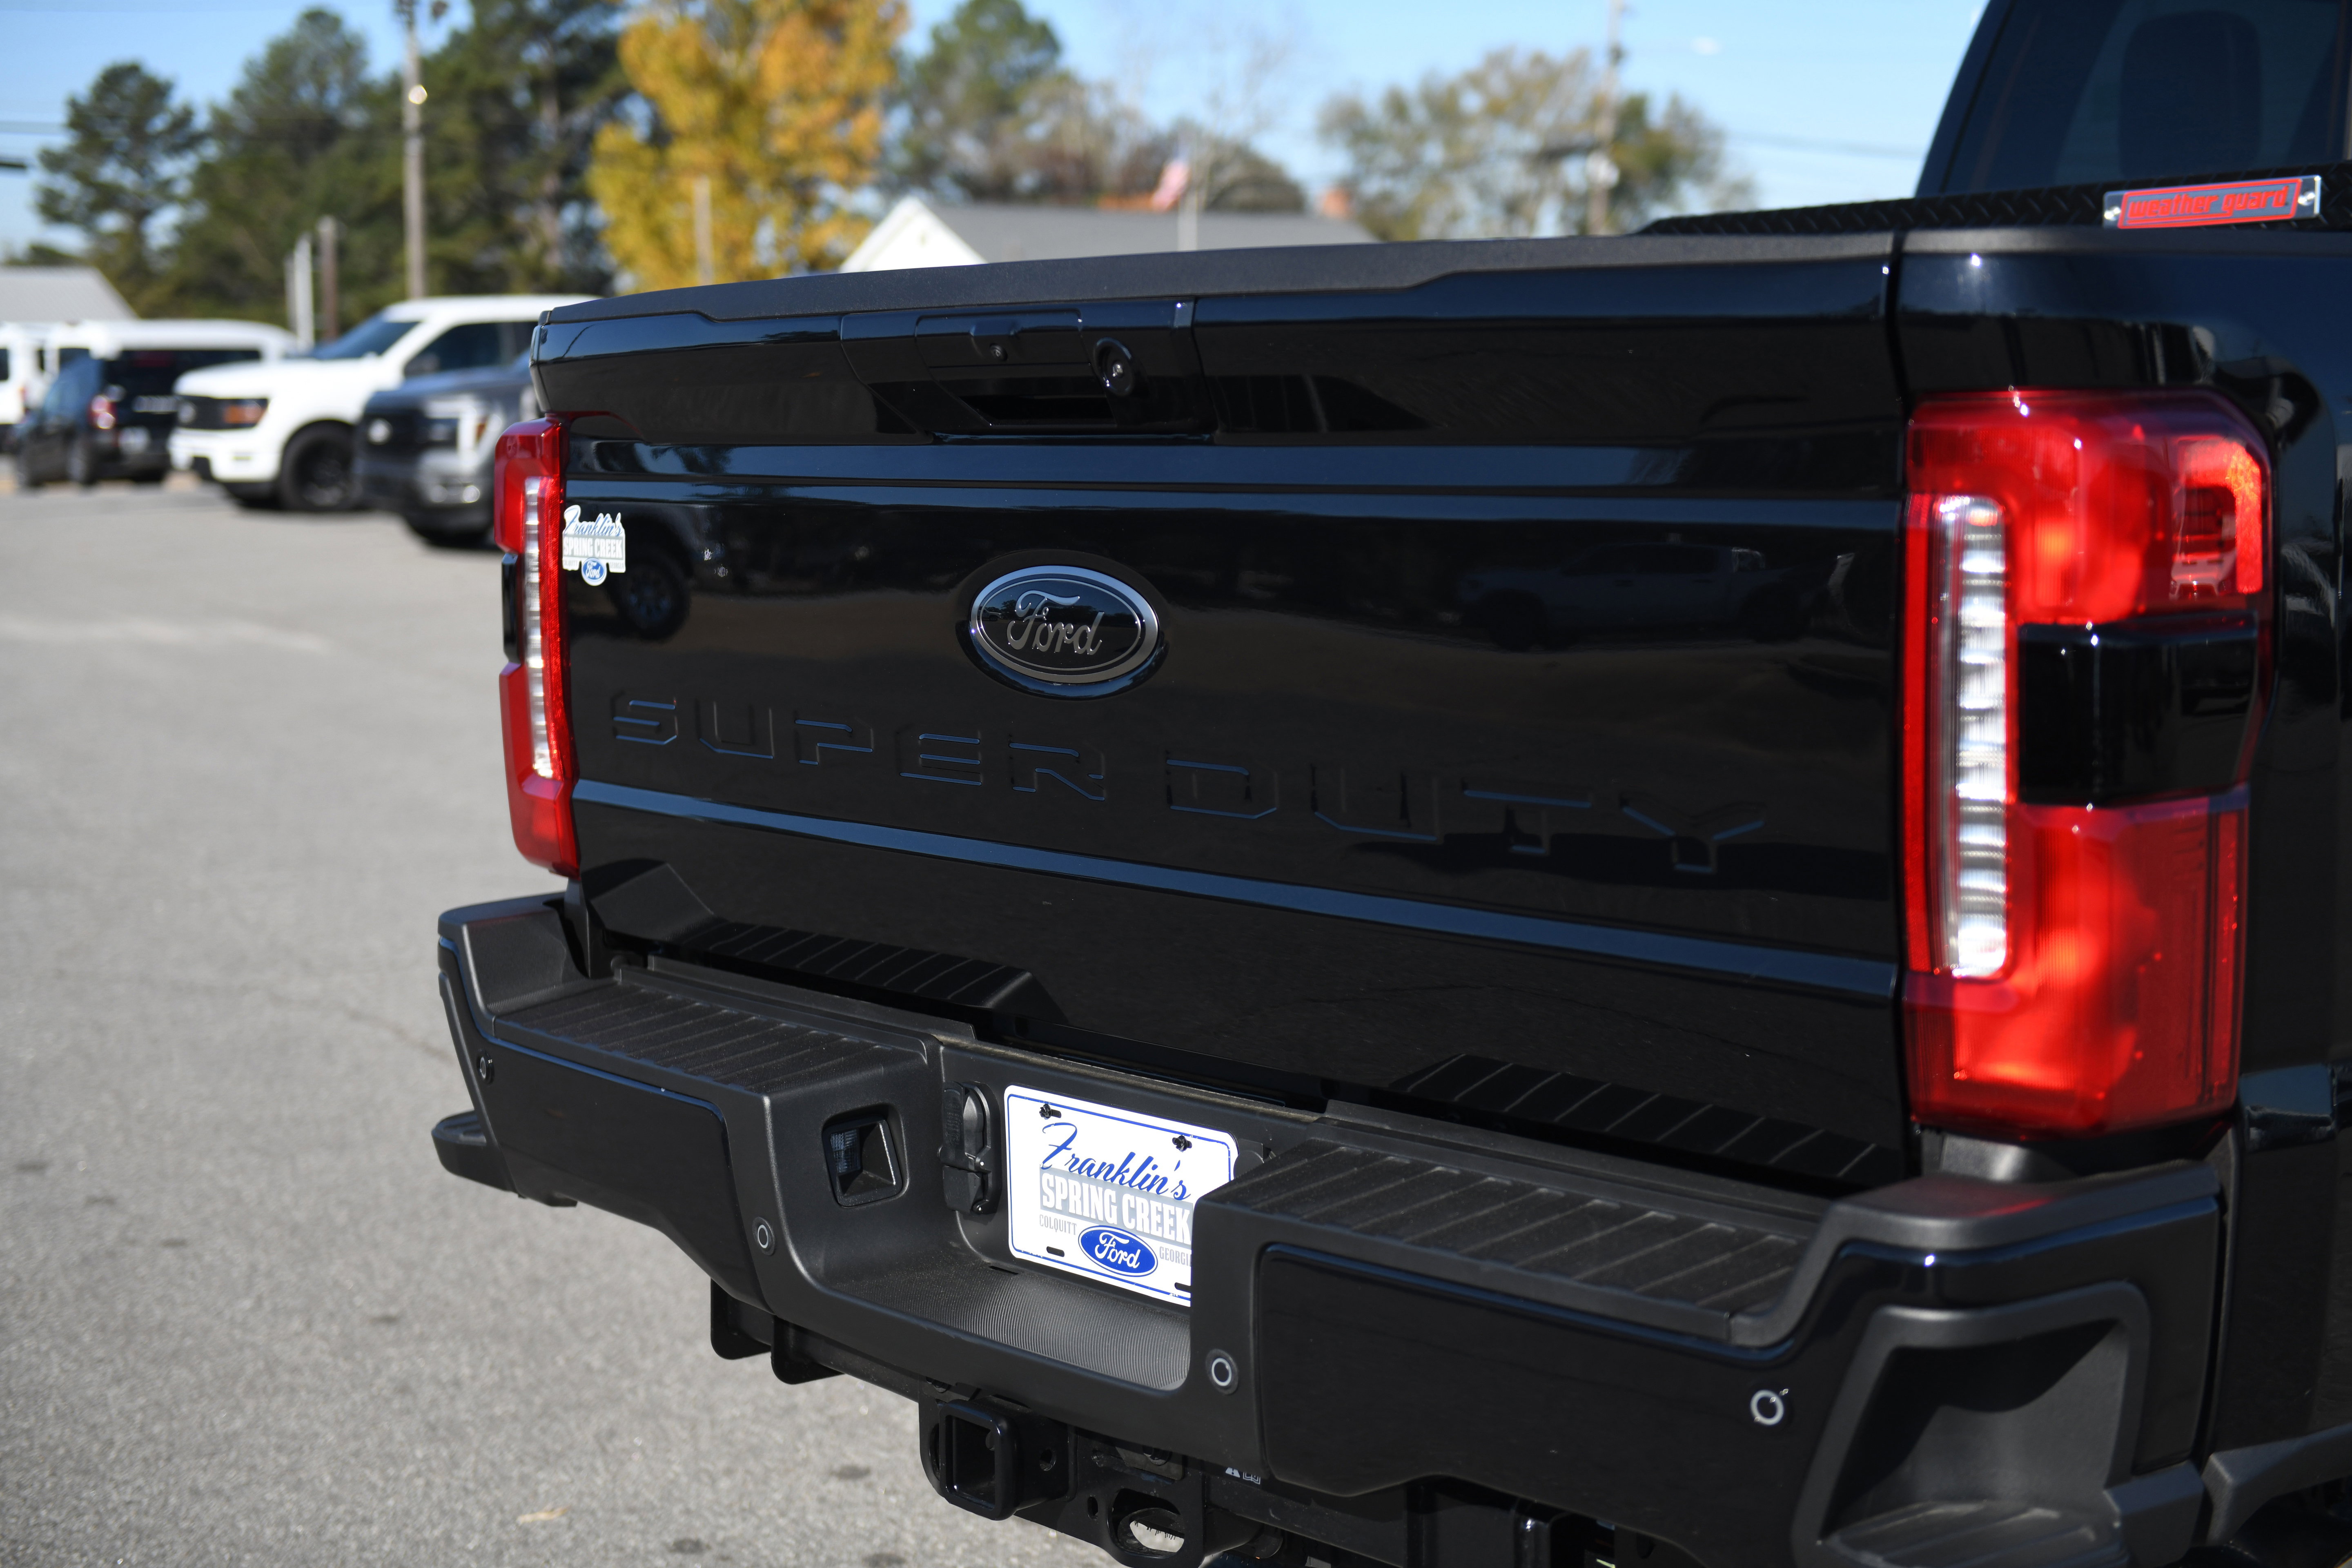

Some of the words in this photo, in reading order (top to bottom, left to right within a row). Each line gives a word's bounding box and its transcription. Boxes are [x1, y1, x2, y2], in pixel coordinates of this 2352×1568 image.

[2129, 194, 2218, 217] weather
[2223, 186, 2289, 215] guard
[564, 508, 623, 537] Franklin's
[564, 537, 593, 557] SPRING
[594, 538, 622, 558] CREEK
[586, 561, 600, 578] Ford
[1007, 590, 1104, 655] Ford
[610, 691, 1106, 801] SUPER
[1165, 748, 1767, 873] DUTY
[1040, 1122, 1191, 1200] Franklin's
[1040, 1214, 1077, 1235] COLQUITT
[1042, 1173, 1117, 1225] SPRING
[1122, 1194, 1192, 1245] CREEK
[1095, 1232, 1140, 1269] Ford
